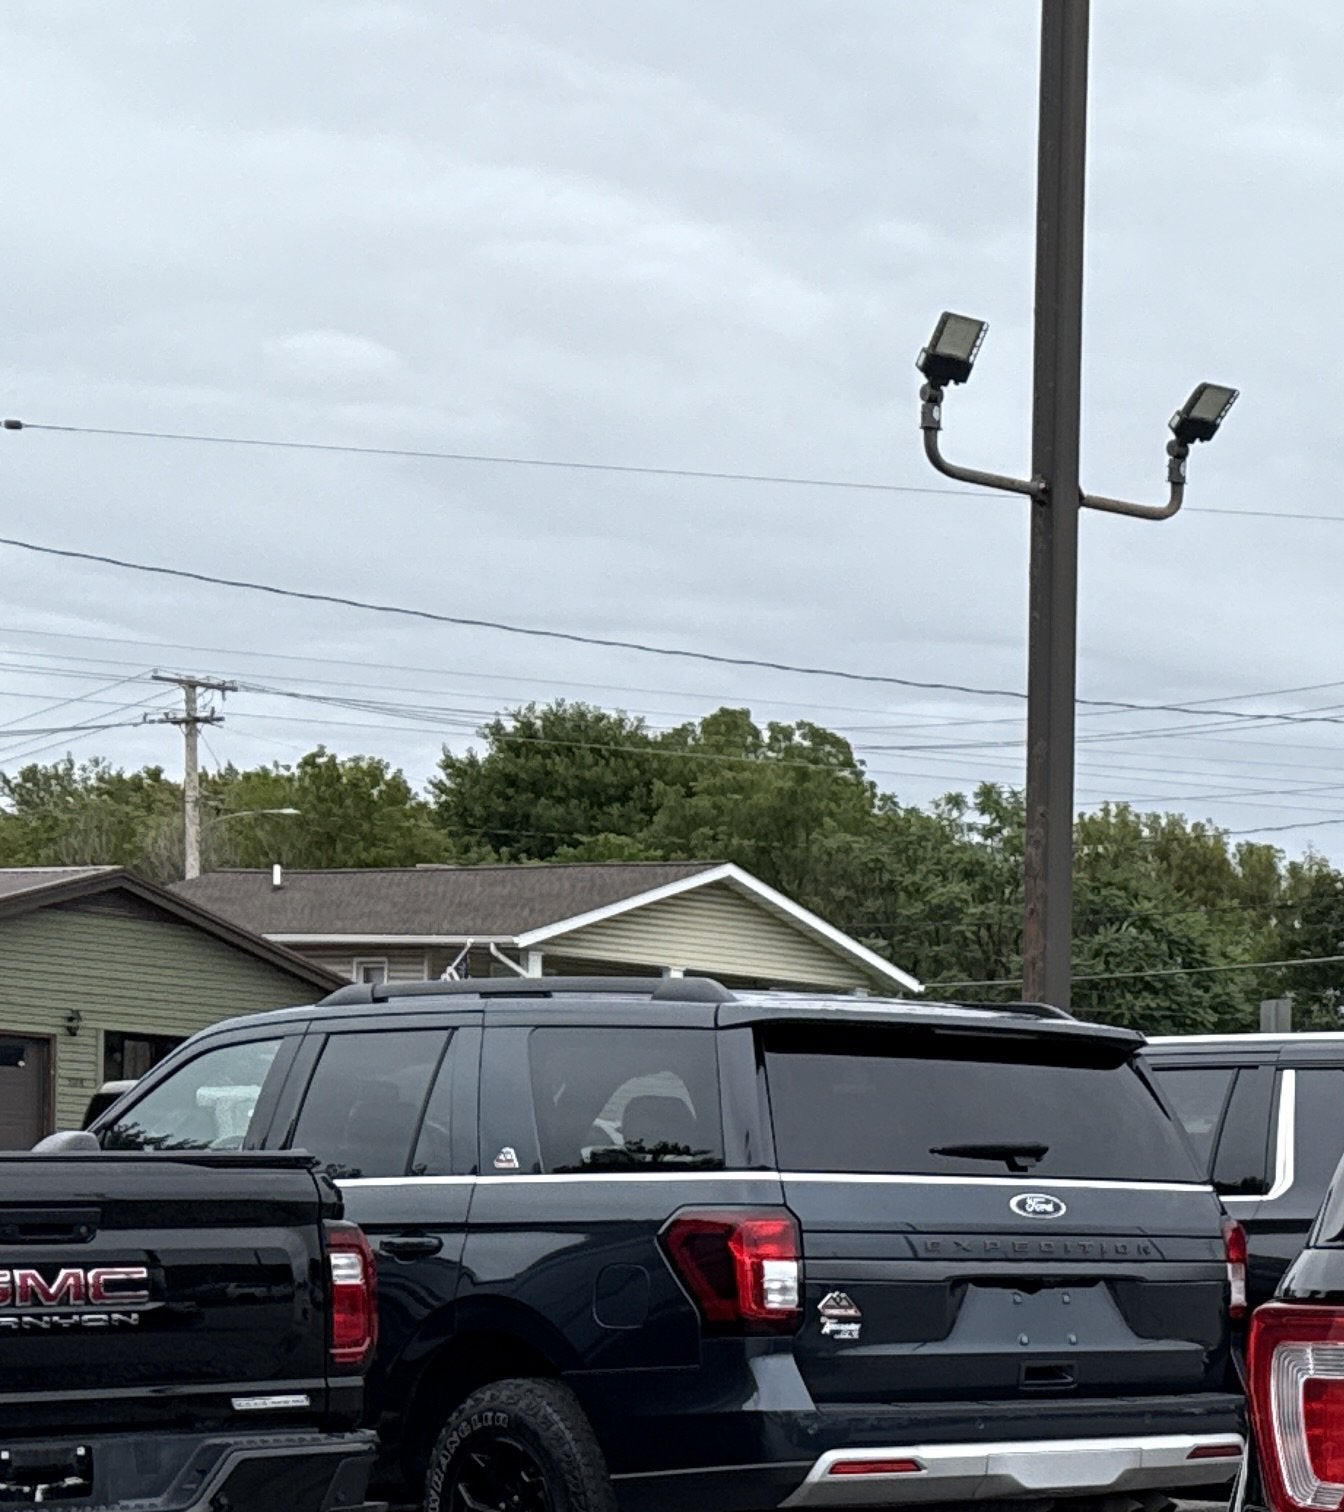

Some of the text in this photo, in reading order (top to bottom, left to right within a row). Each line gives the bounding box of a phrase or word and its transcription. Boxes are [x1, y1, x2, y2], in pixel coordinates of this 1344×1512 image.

[1024, 1195, 1054, 1213] Ford
[924, 1240, 1152, 1257] EXPEDITION
[0, 1267, 149, 1307] MC
